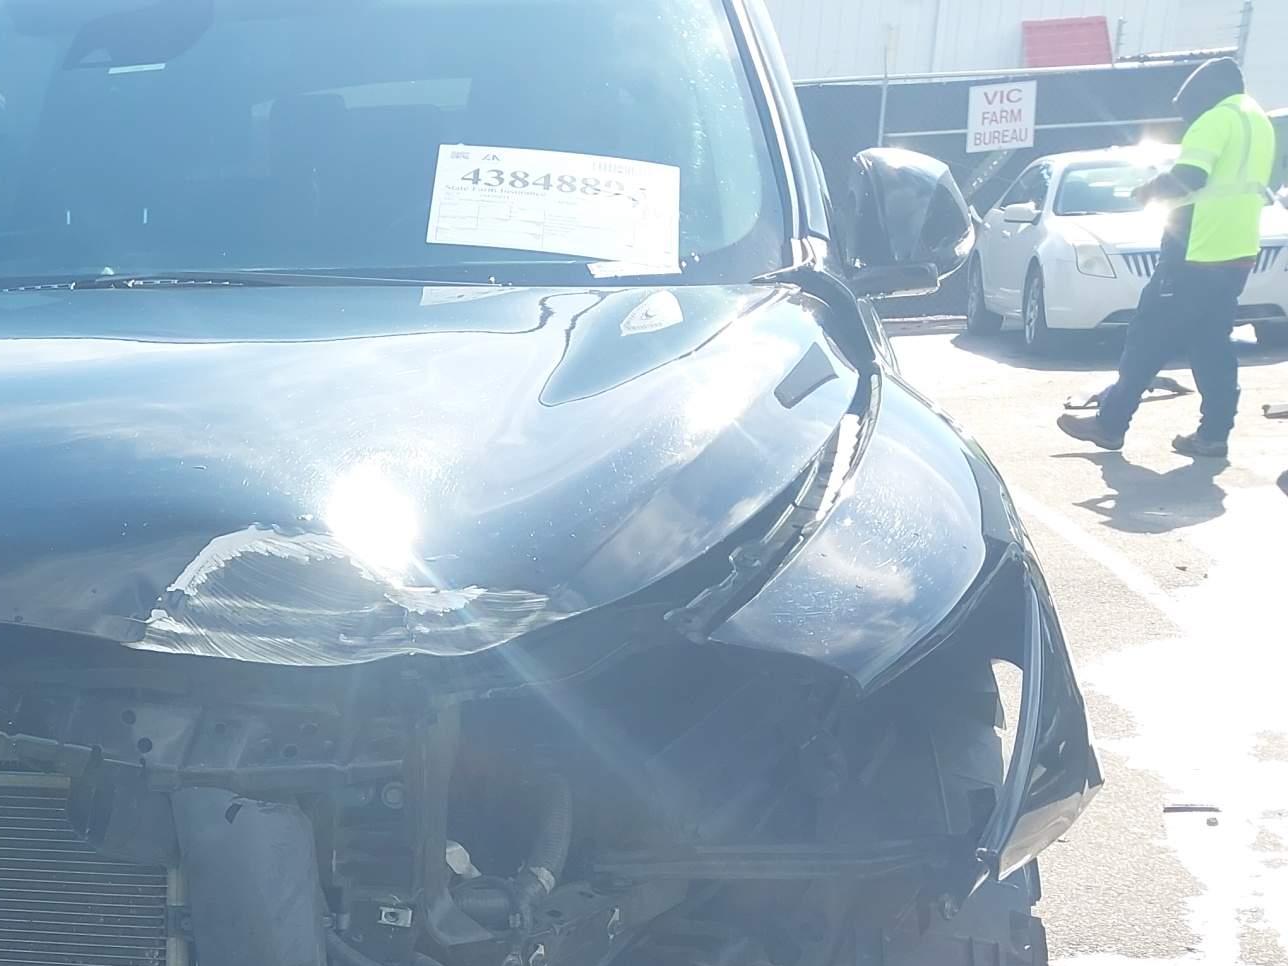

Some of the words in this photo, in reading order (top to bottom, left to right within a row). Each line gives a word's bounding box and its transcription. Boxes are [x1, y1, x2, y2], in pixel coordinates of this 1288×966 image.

[983, 88, 1023, 105] VIC
[981, 108, 1022, 126] FARM
[973, 127, 1028, 146] BUREAU
